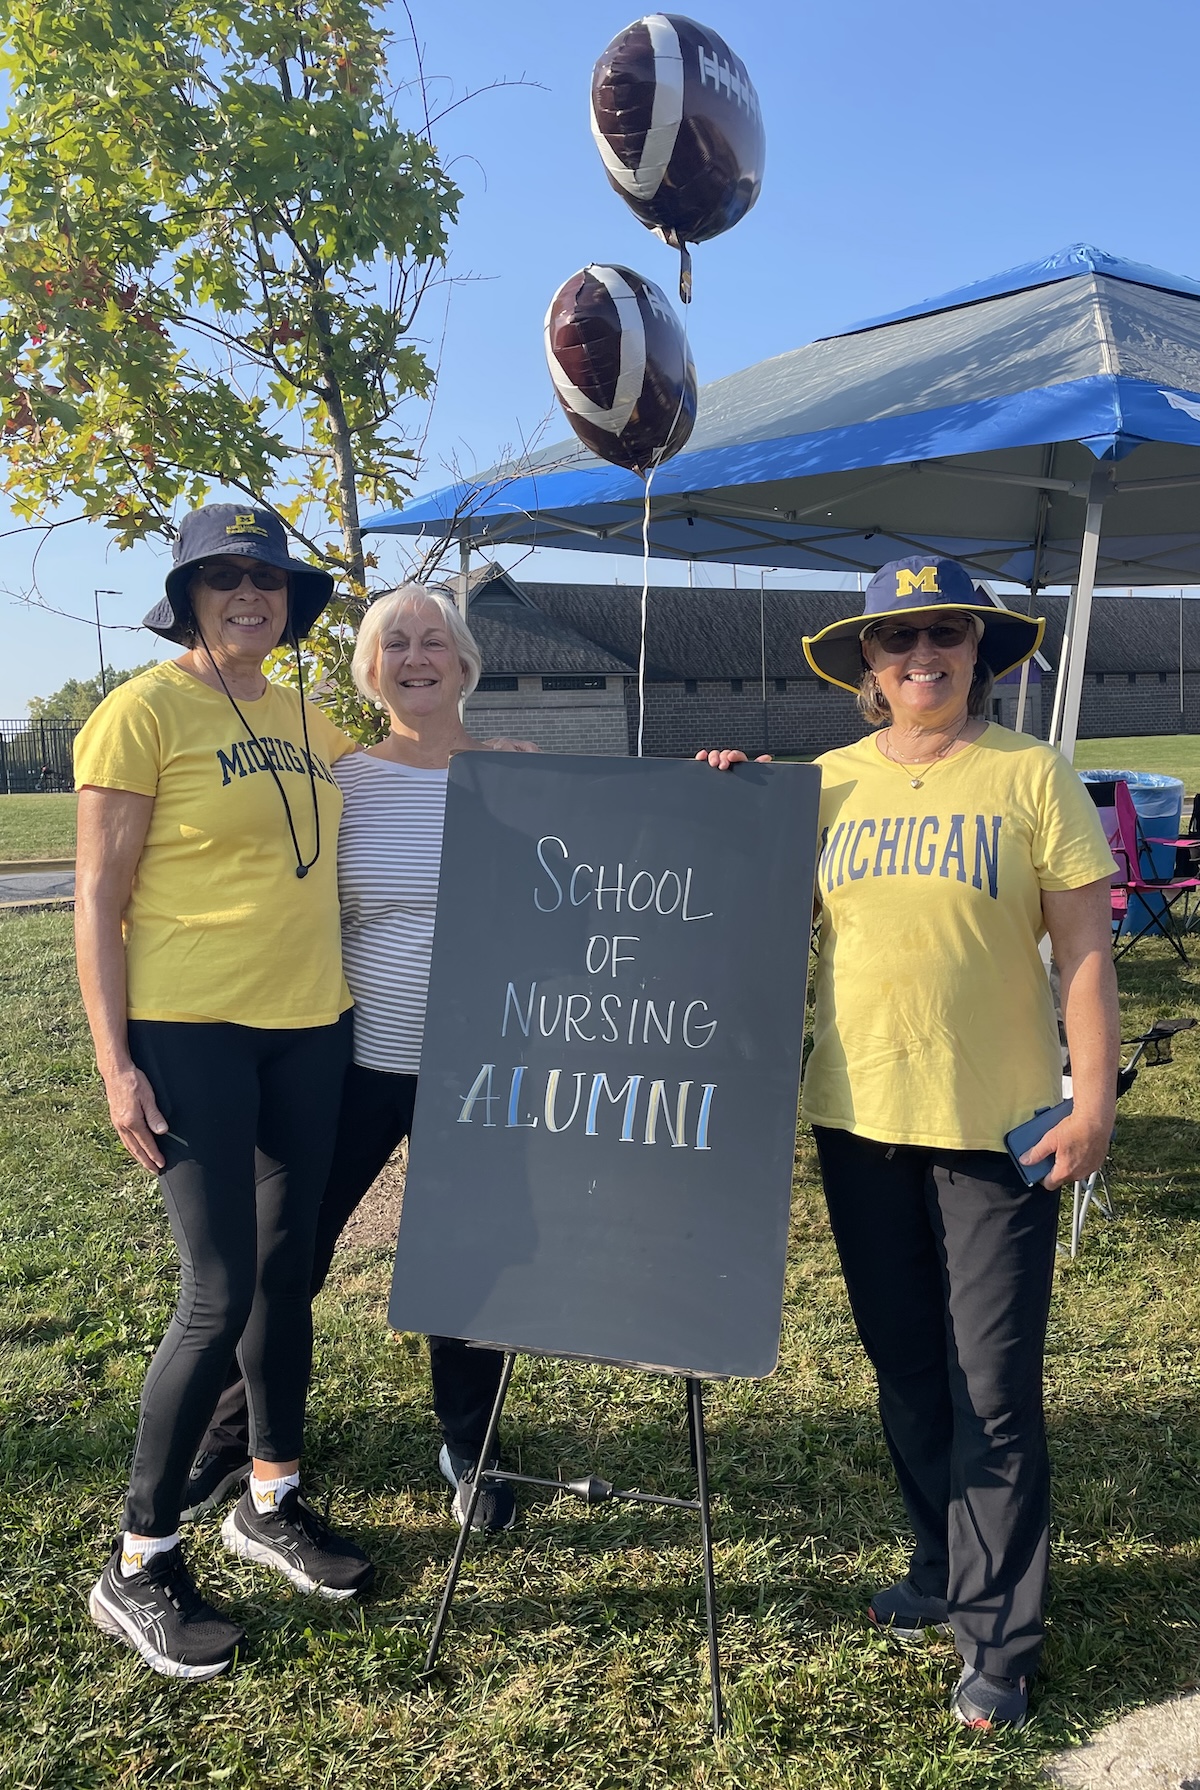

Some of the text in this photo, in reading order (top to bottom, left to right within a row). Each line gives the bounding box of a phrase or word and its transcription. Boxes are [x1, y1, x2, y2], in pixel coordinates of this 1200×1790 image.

[896, 566, 938, 597] M
[216, 736, 339, 789] MICHIGAN
[534, 834, 714, 922] SCHOOL
[818, 814, 1002, 900] MICHIGAN
[586, 935, 640, 978] OF
[502, 981, 718, 1049] NURSING
[457, 1063, 717, 1150] ALUMNI
[254, 1490, 277, 1507] M
[121, 1551, 144, 1569] M
